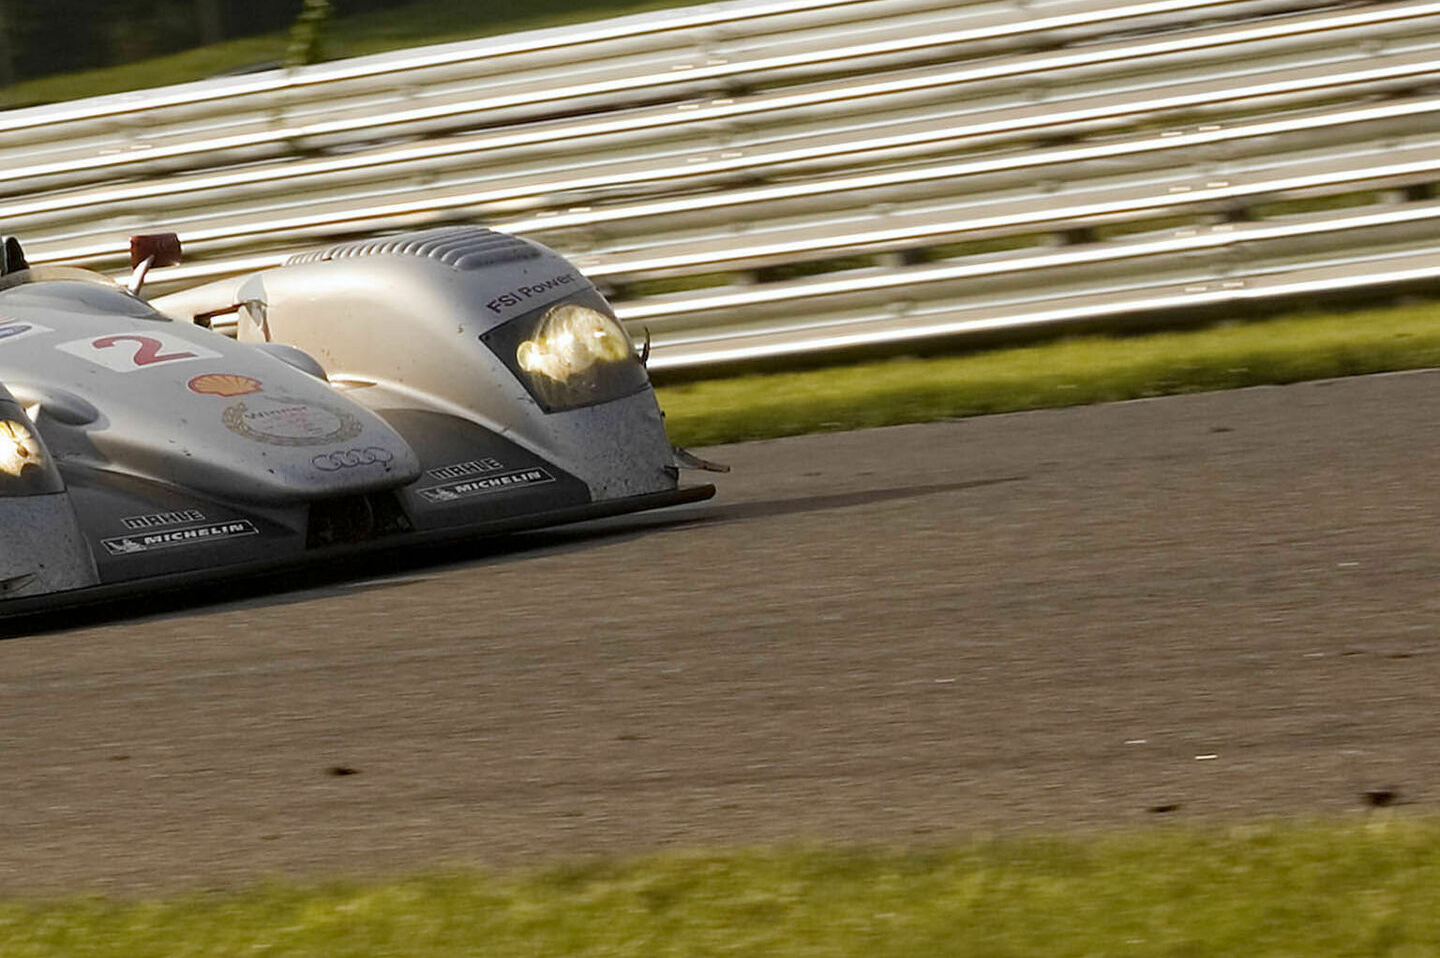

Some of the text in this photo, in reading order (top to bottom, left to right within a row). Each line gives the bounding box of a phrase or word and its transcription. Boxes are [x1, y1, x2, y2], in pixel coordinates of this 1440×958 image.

[486, 273, 576, 314] FSI Power
[93, 335, 199, 366] 2
[454, 470, 542, 493] MICHELIN
[120, 509, 206, 530] MAHLE
[143, 523, 244, 545] MICHELIN
